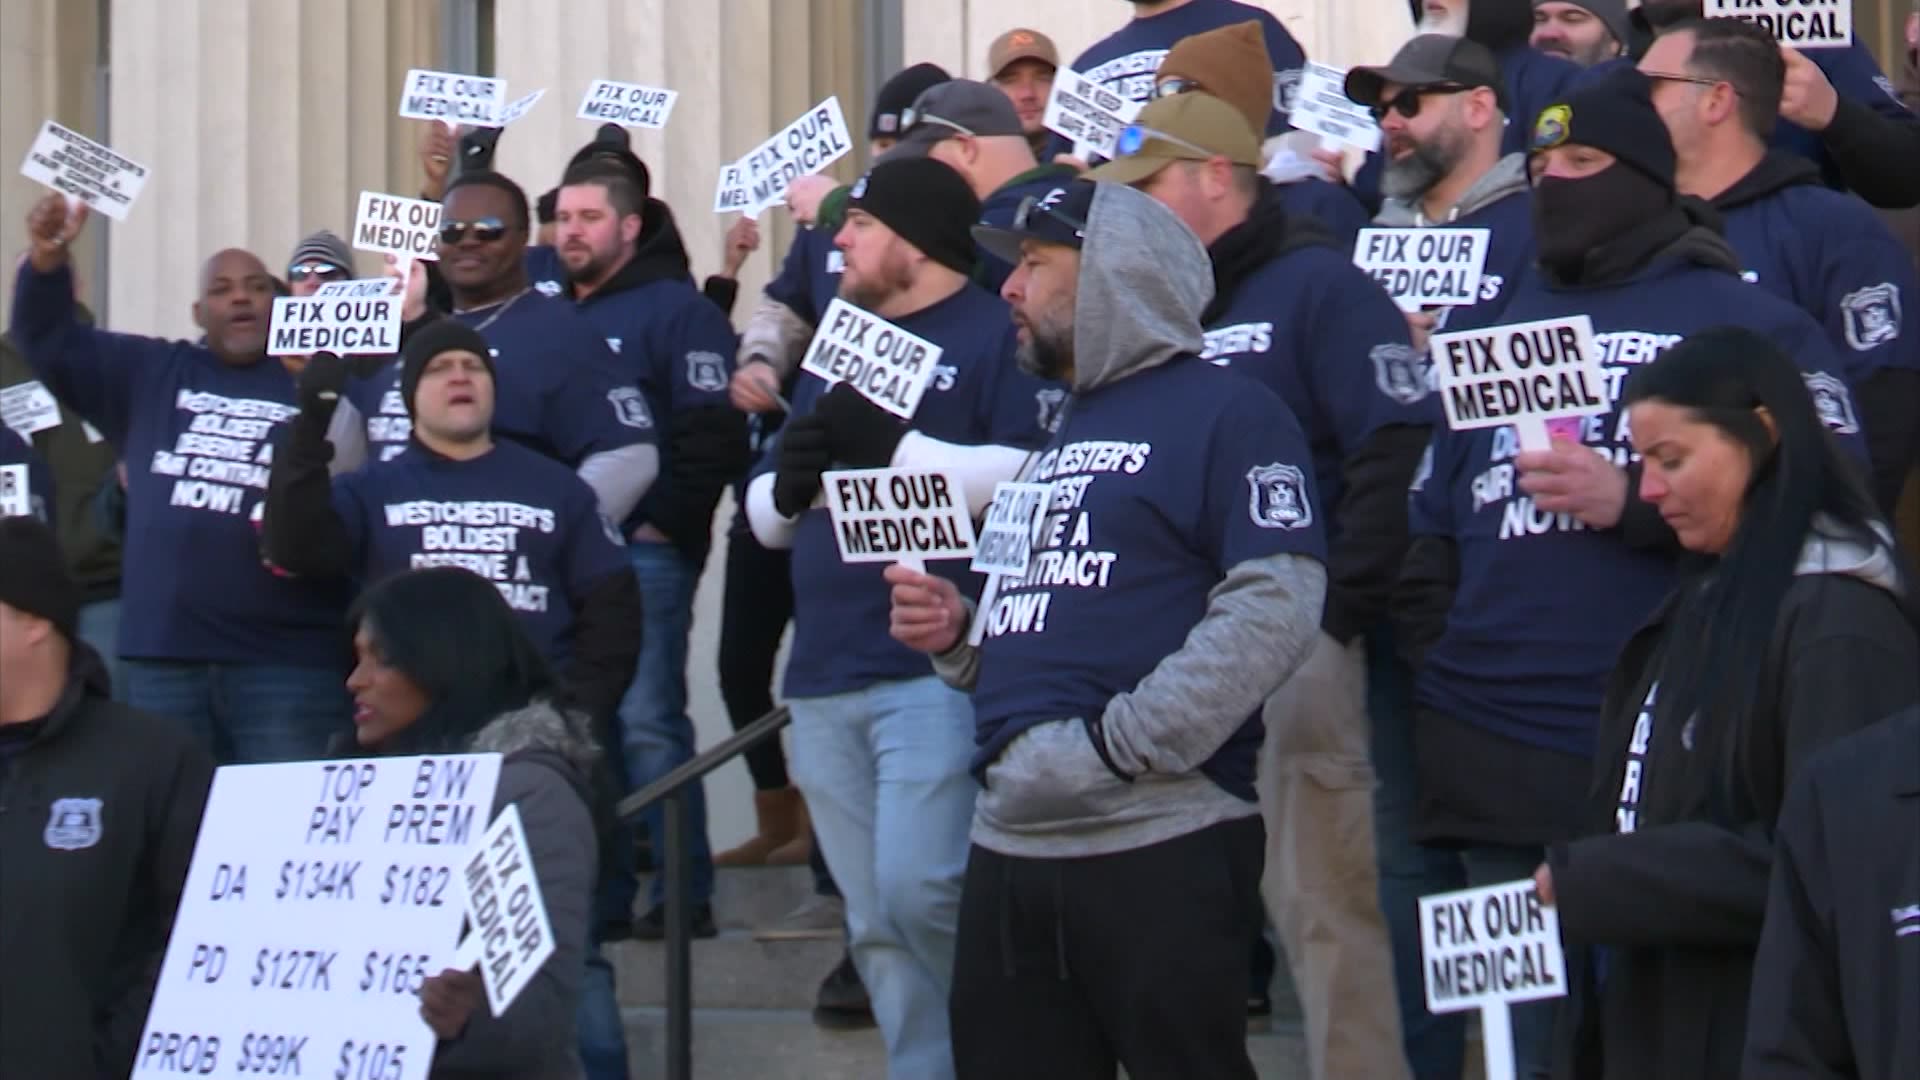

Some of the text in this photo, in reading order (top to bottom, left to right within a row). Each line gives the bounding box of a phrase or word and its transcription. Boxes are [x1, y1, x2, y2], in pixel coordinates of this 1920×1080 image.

[1735, 12, 1844, 40] DICAL
[416, 74, 495, 99] FIX OUR
[595, 83, 668, 106] FIX OUR
[407, 95, 493, 121] MEDICAL
[583, 101, 661, 125] MEDICAL
[748, 107, 832, 178] FIX OUR
[725, 168, 741, 186] FI
[752, 132, 845, 203] MEDICAL
[368, 199, 439, 228] FIX OU
[359, 223, 438, 254] MEDICA
[1366, 234, 1474, 262] FIX OUR
[1373, 268, 1472, 297] EDICAL
[284, 302, 390, 323] FIX OUR
[275, 327, 391, 349] MEDICAL
[830, 308, 928, 375] FIX OUR
[1447, 336, 1501, 377] FIX
[1510, 326, 1582, 369] OUR
[810, 338, 913, 410] MEDICAL
[1450, 371, 1599, 421] MEDICAL
[170, 480, 244, 514] NOW!
[838, 474, 953, 512] FIX OUR
[384, 500, 556, 533] WESTCHESTER'S
[842, 514, 968, 554] MEDICAL
[1069, 512, 1089, 546] A
[422, 525, 519, 552] BOLDEST
[513, 555, 532, 581] A
[320, 759, 477, 803] TOP B/W
[304, 804, 475, 845] PAY PREM
[209, 861, 450, 907] DA $134K $182
[491, 824, 542, 964] FIX OUR
[464, 849, 517, 1003] MEDICAL
[1431, 890, 1545, 948] FIX OUR
[187, 945, 430, 996] PD $127K $165
[1431, 943, 1556, 1000] MEDICAL
[141, 1031, 408, 1080] PROB $99K $105
